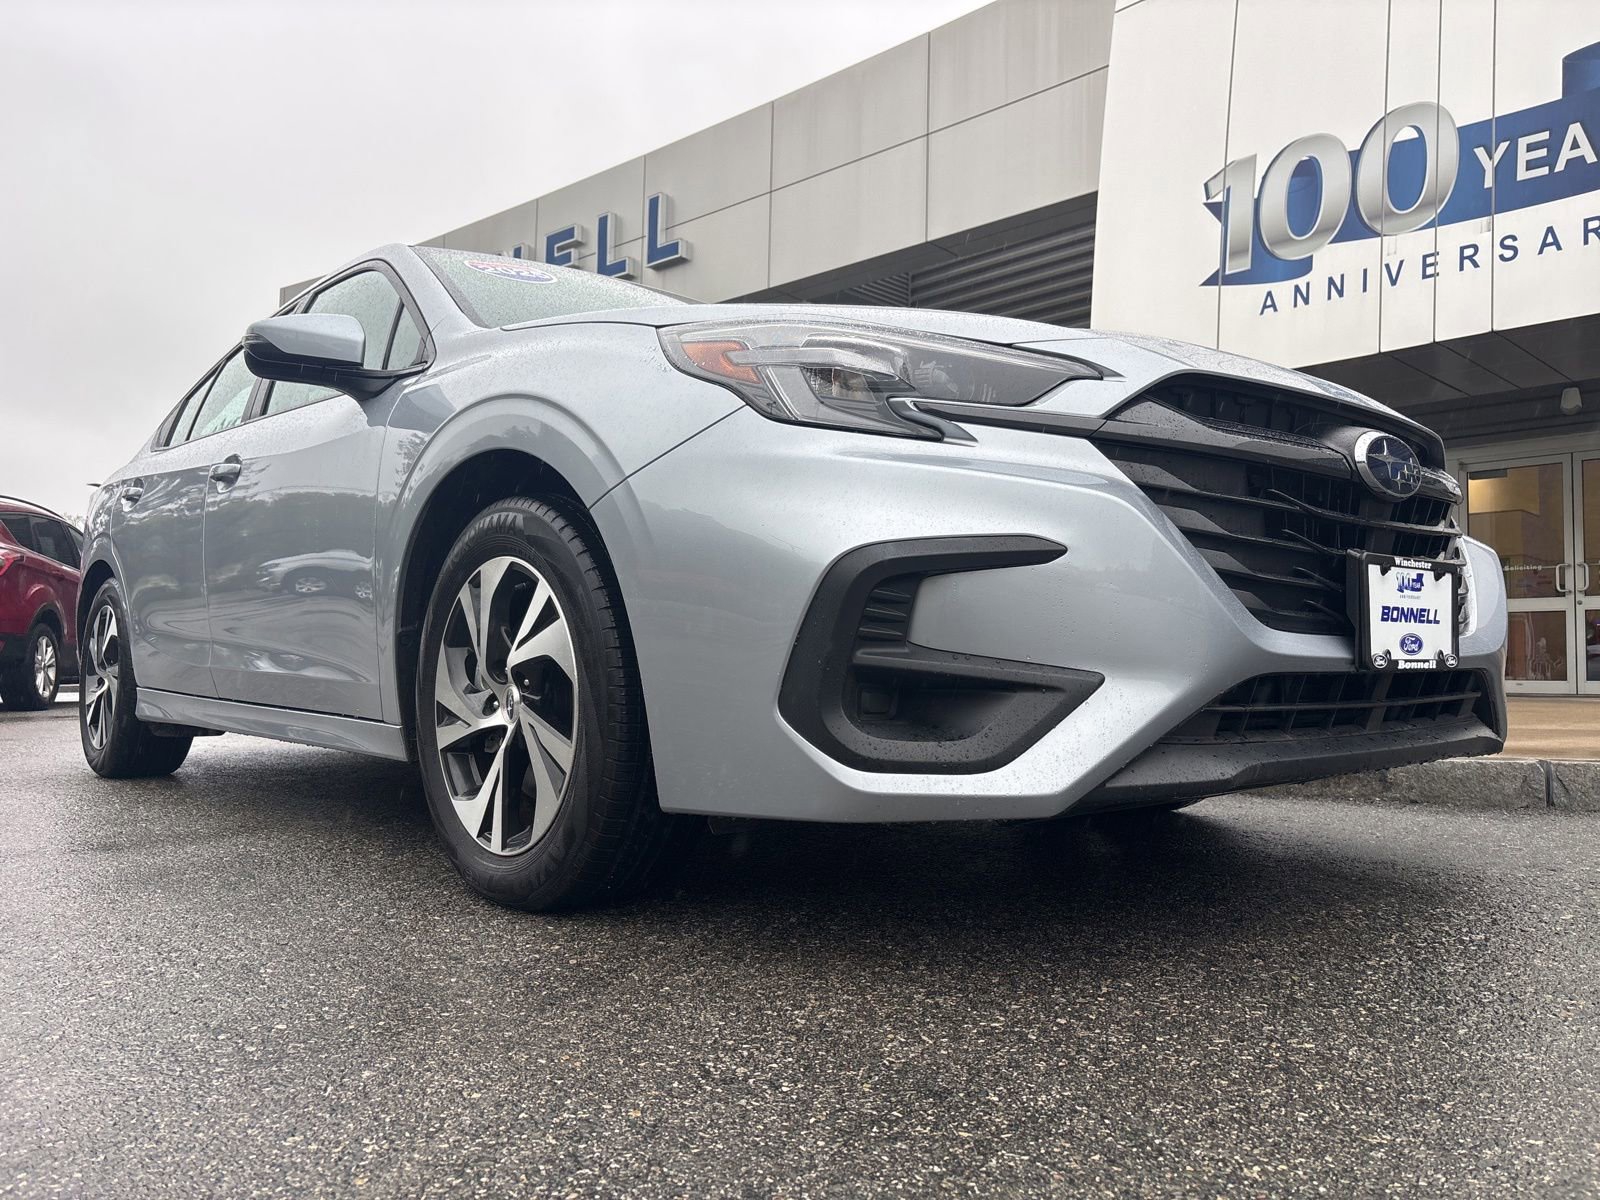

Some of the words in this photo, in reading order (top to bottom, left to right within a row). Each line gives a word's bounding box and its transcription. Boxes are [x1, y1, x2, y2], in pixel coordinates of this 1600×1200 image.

[1203, 101, 1459, 275] 100
[1473, 122, 1599, 189] YEA
[1259, 215, 1600, 316] ANNIVERSAR
[1394, 556, 1432, 569] Winchester
[1380, 605, 1440, 625] BONNELL
[1403, 636, 1420, 652] Ford
[1397, 660, 1437, 670] Bonnell
